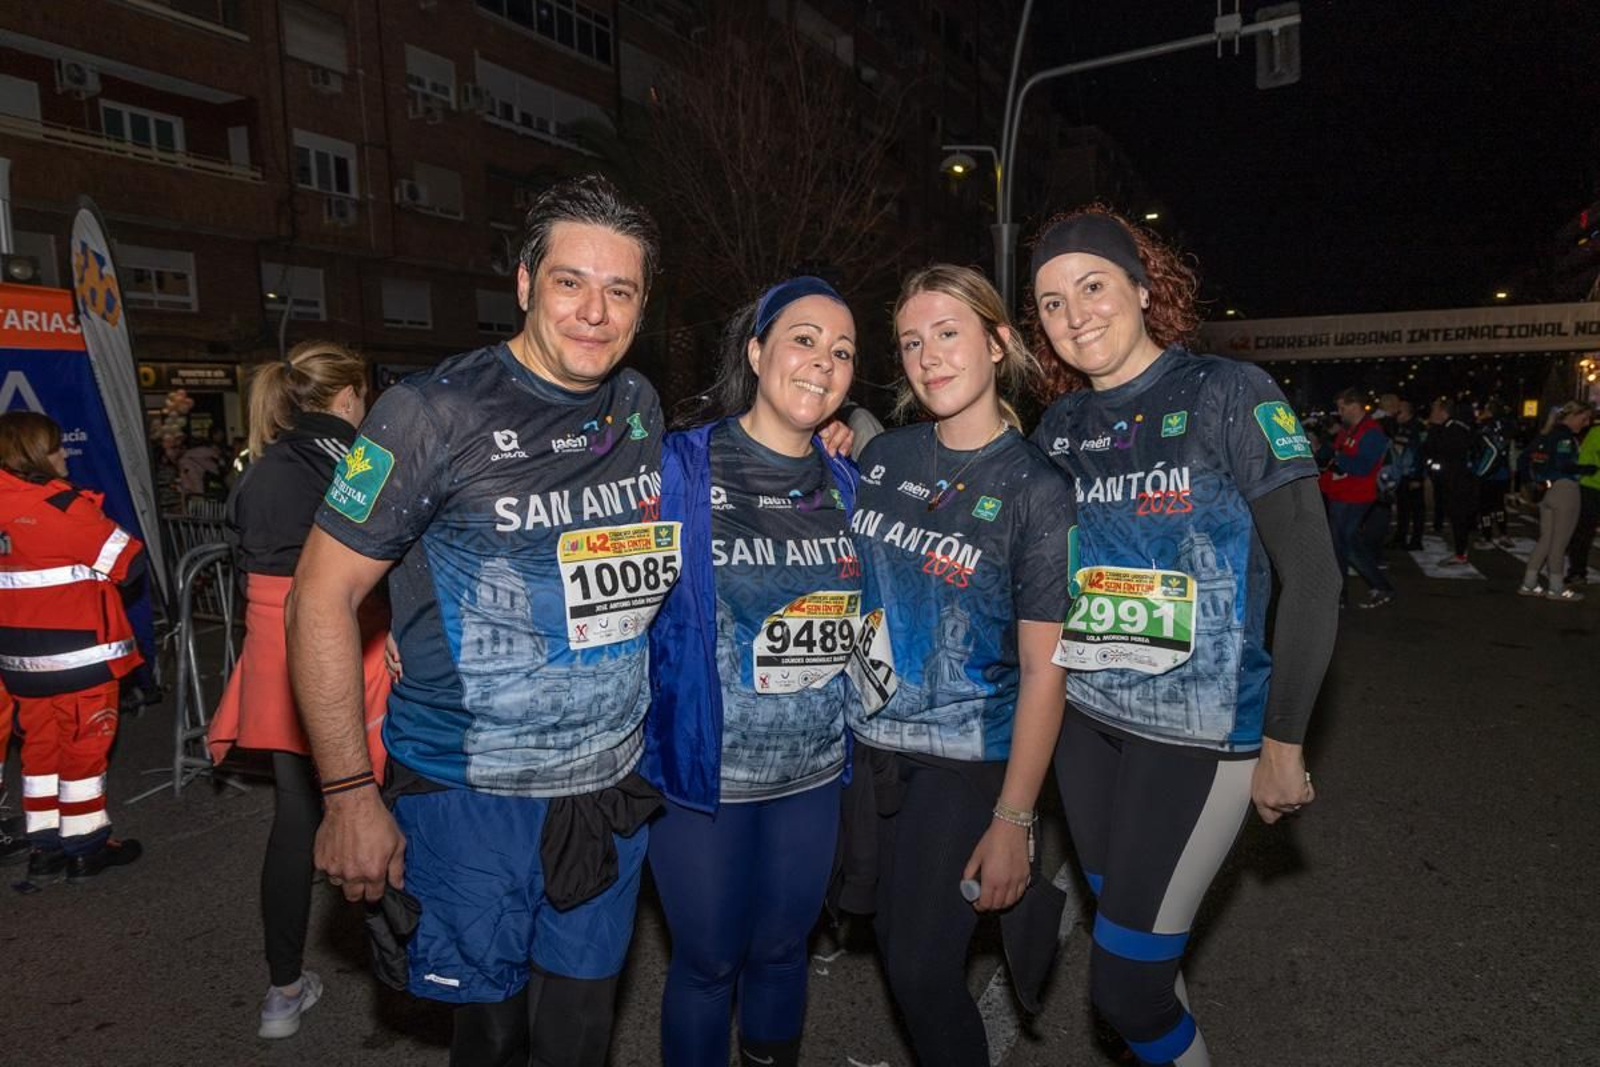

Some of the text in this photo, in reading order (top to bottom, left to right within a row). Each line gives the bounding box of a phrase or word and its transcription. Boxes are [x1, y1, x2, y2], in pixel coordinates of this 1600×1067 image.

[0, 308, 82, 334] ARIAS
[1255, 332, 1331, 350] CARRERA
[1333, 330, 1402, 347] URBANA
[1406, 322, 1568, 344] INTERNACIONAL
[1086, 461, 1191, 504] ANTÓN
[494, 489, 573, 533] SAN
[1135, 489, 1194, 516] 2025
[585, 532, 611, 555] 42
[710, 537, 777, 567] SAN
[883, 520, 983, 575] ANTÓN
[569, 554, 679, 601] 10085
[921, 549, 976, 588] 2025
[1067, 595, 1175, 638] 2991
[765, 618, 855, 655] 9489
